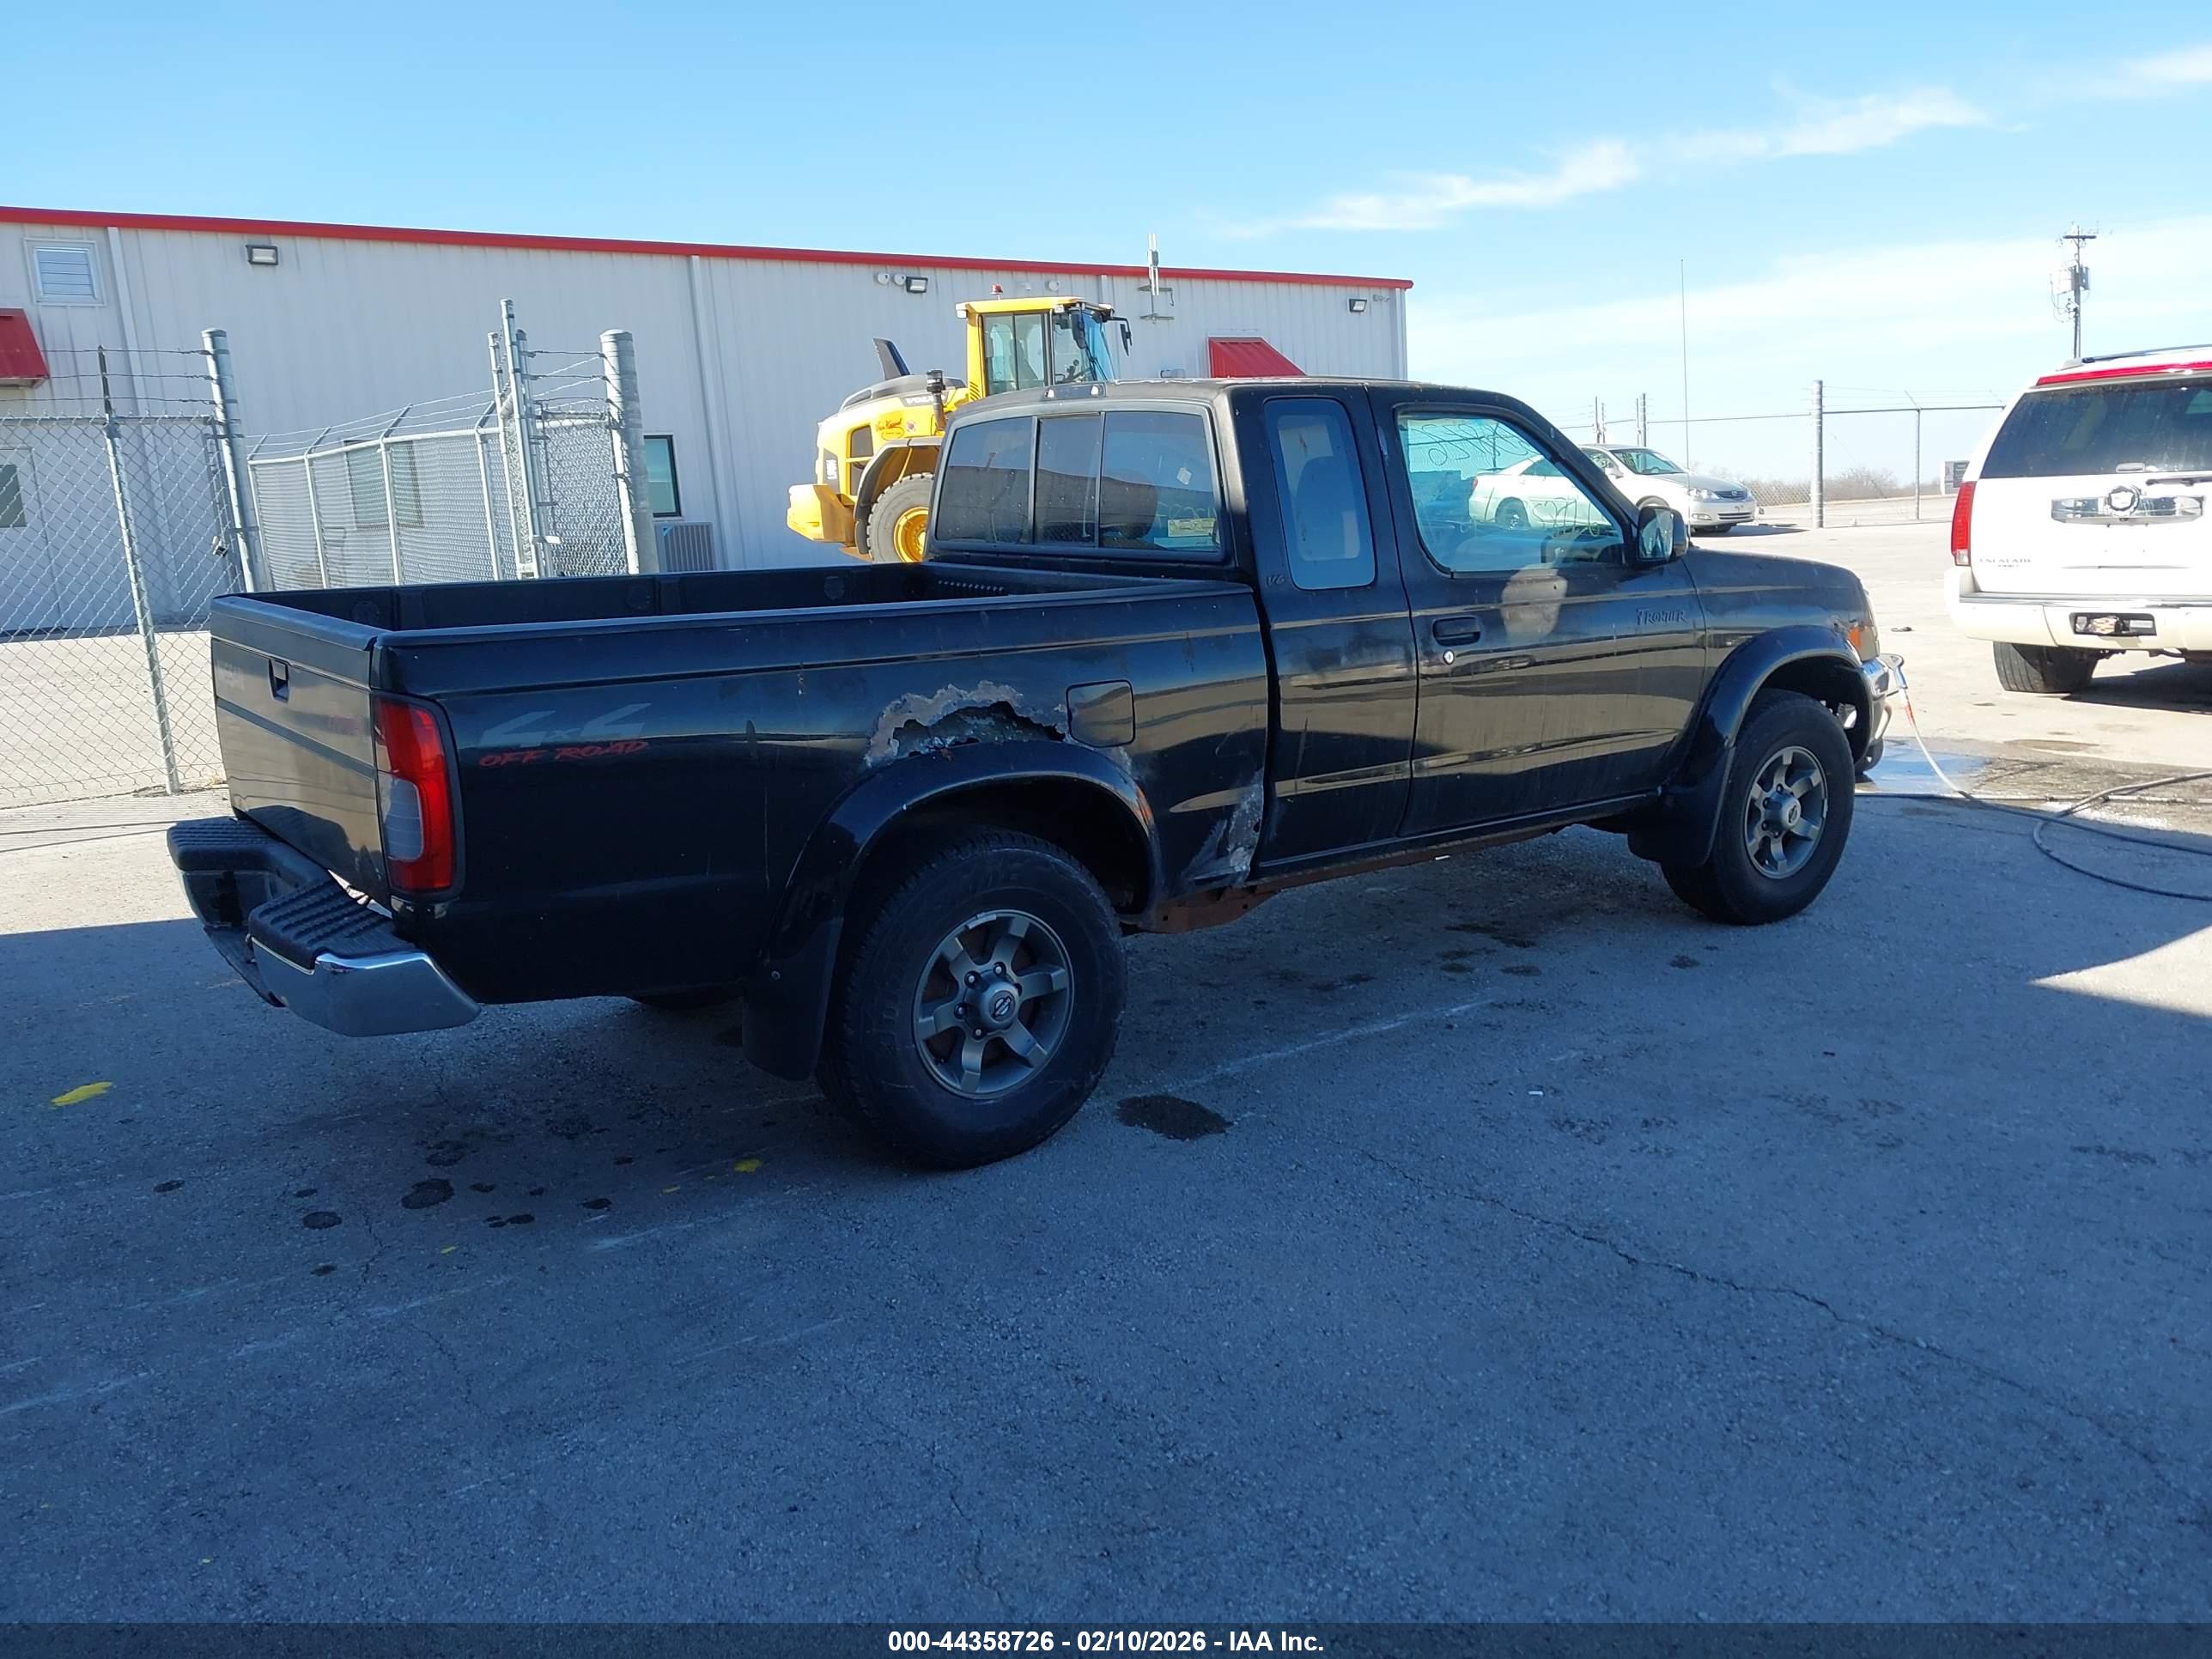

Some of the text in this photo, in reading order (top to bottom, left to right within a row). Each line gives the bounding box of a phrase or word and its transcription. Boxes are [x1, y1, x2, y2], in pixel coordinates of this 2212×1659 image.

[1266, 574, 1286, 586] V6
[479, 739, 650, 768] OFF ROAD
